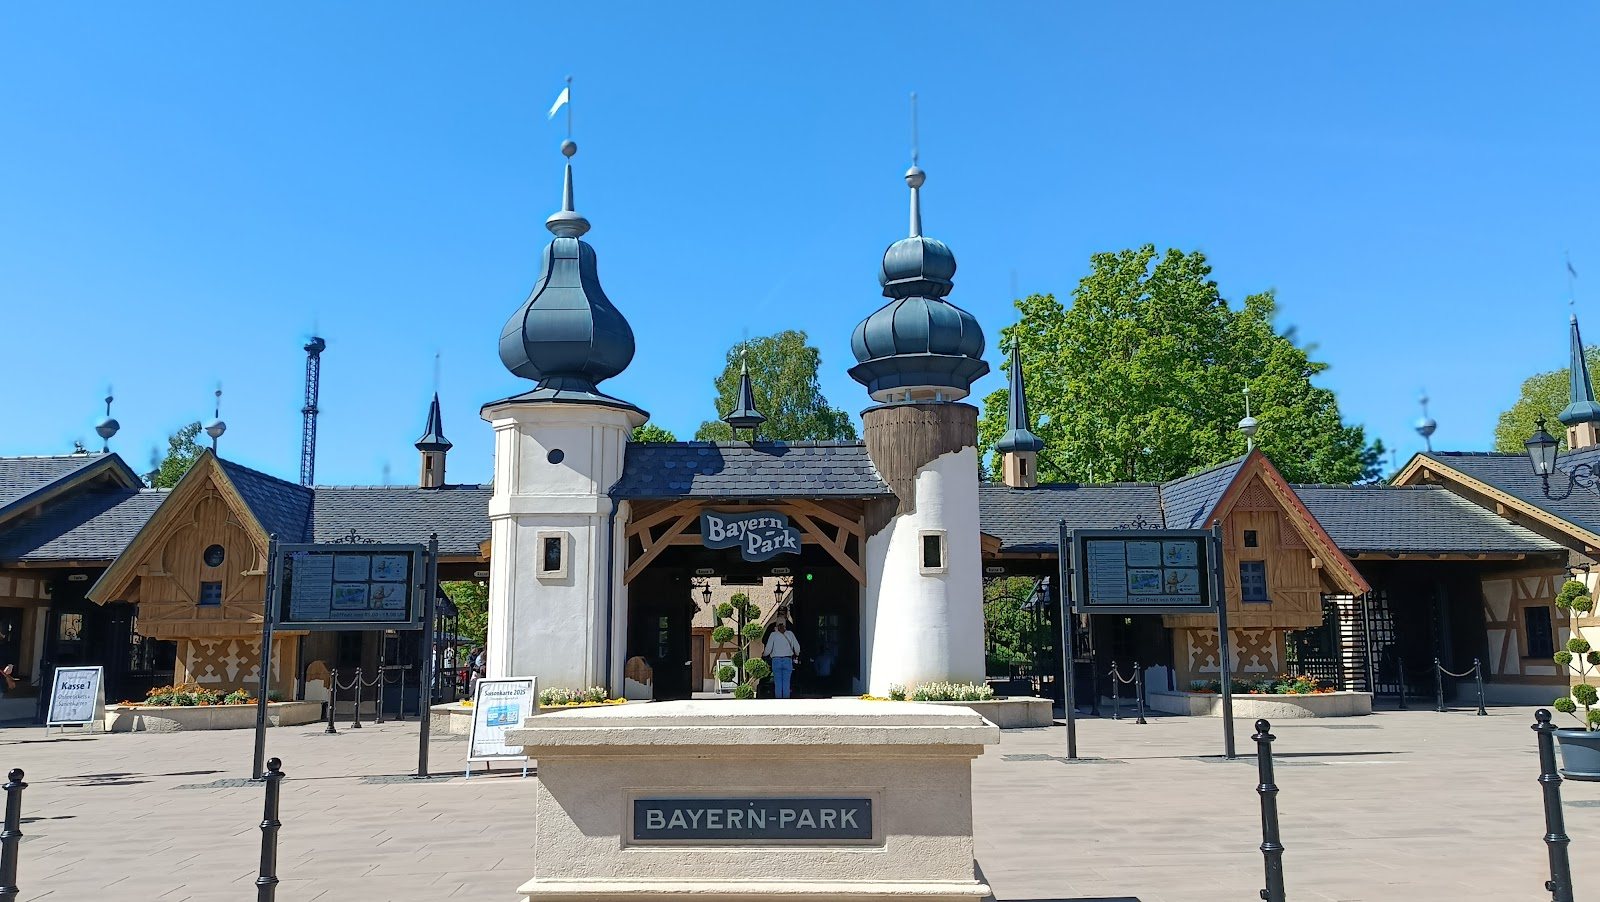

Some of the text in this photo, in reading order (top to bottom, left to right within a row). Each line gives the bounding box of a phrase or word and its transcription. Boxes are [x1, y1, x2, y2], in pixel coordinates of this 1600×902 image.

[747, 530, 797, 554] Park
[61, 680, 91, 690] Kasse 1
[513, 688, 526, 696] 2025
[646, 808, 859, 830] BAYERN-PARK
